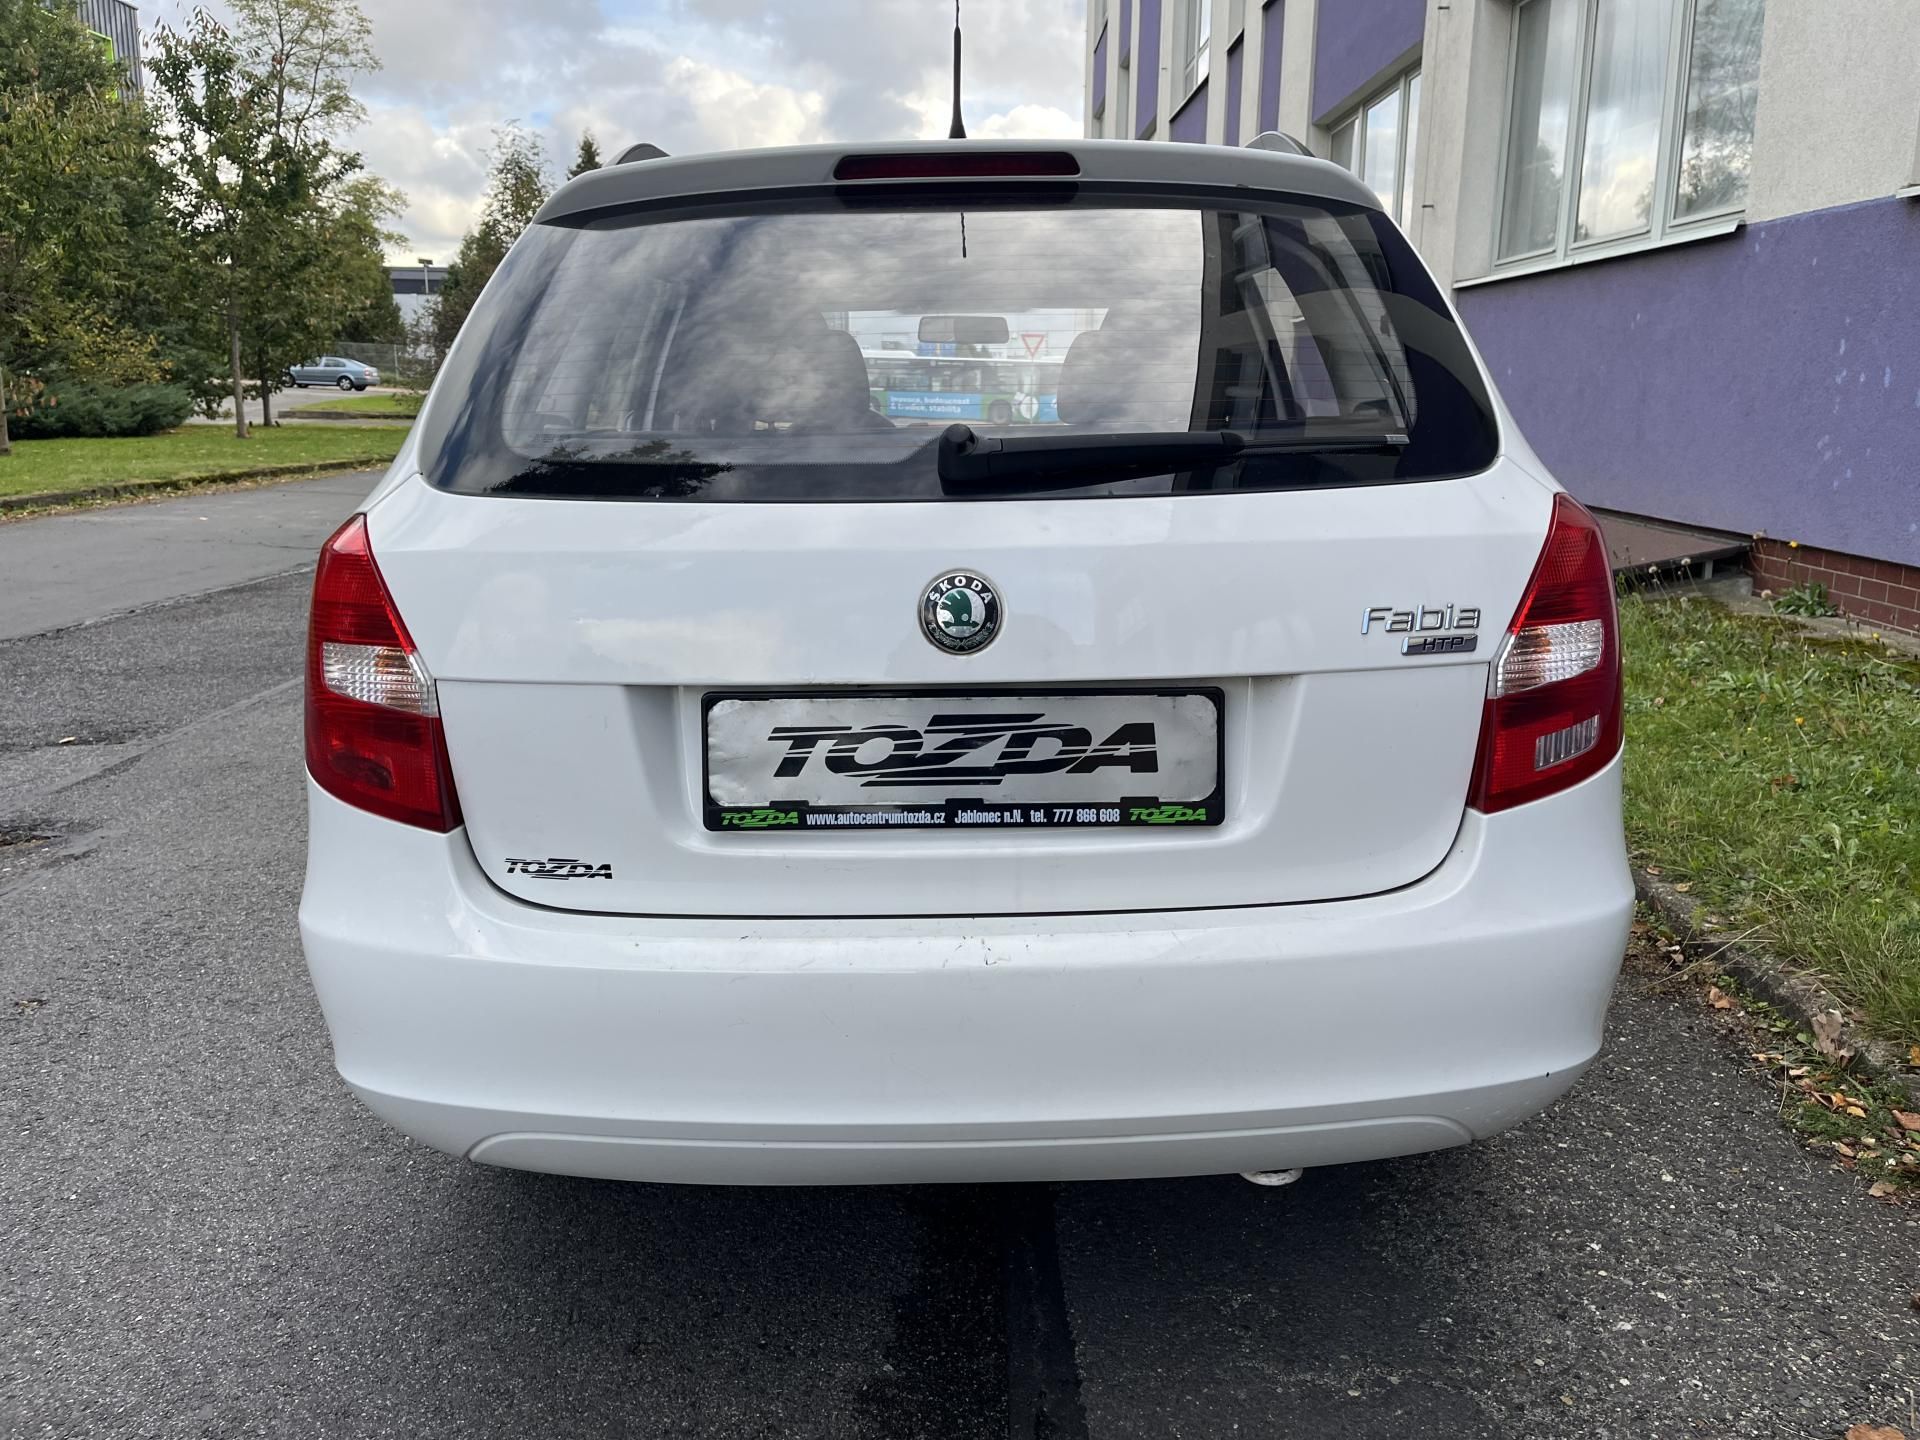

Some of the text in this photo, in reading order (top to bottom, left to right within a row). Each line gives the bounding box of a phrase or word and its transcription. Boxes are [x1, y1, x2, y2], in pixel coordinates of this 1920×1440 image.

[1360, 602, 1481, 635] Fabia
[1422, 636, 1466, 652] HTP
[768, 712, 1159, 787] TOZDA
[720, 805, 1206, 828] TOZDA www.autocentrumtozda.cz Jablonec n.N. tel. 777 866 608 TOZDA
[504, 857, 613, 880] TOZDA
